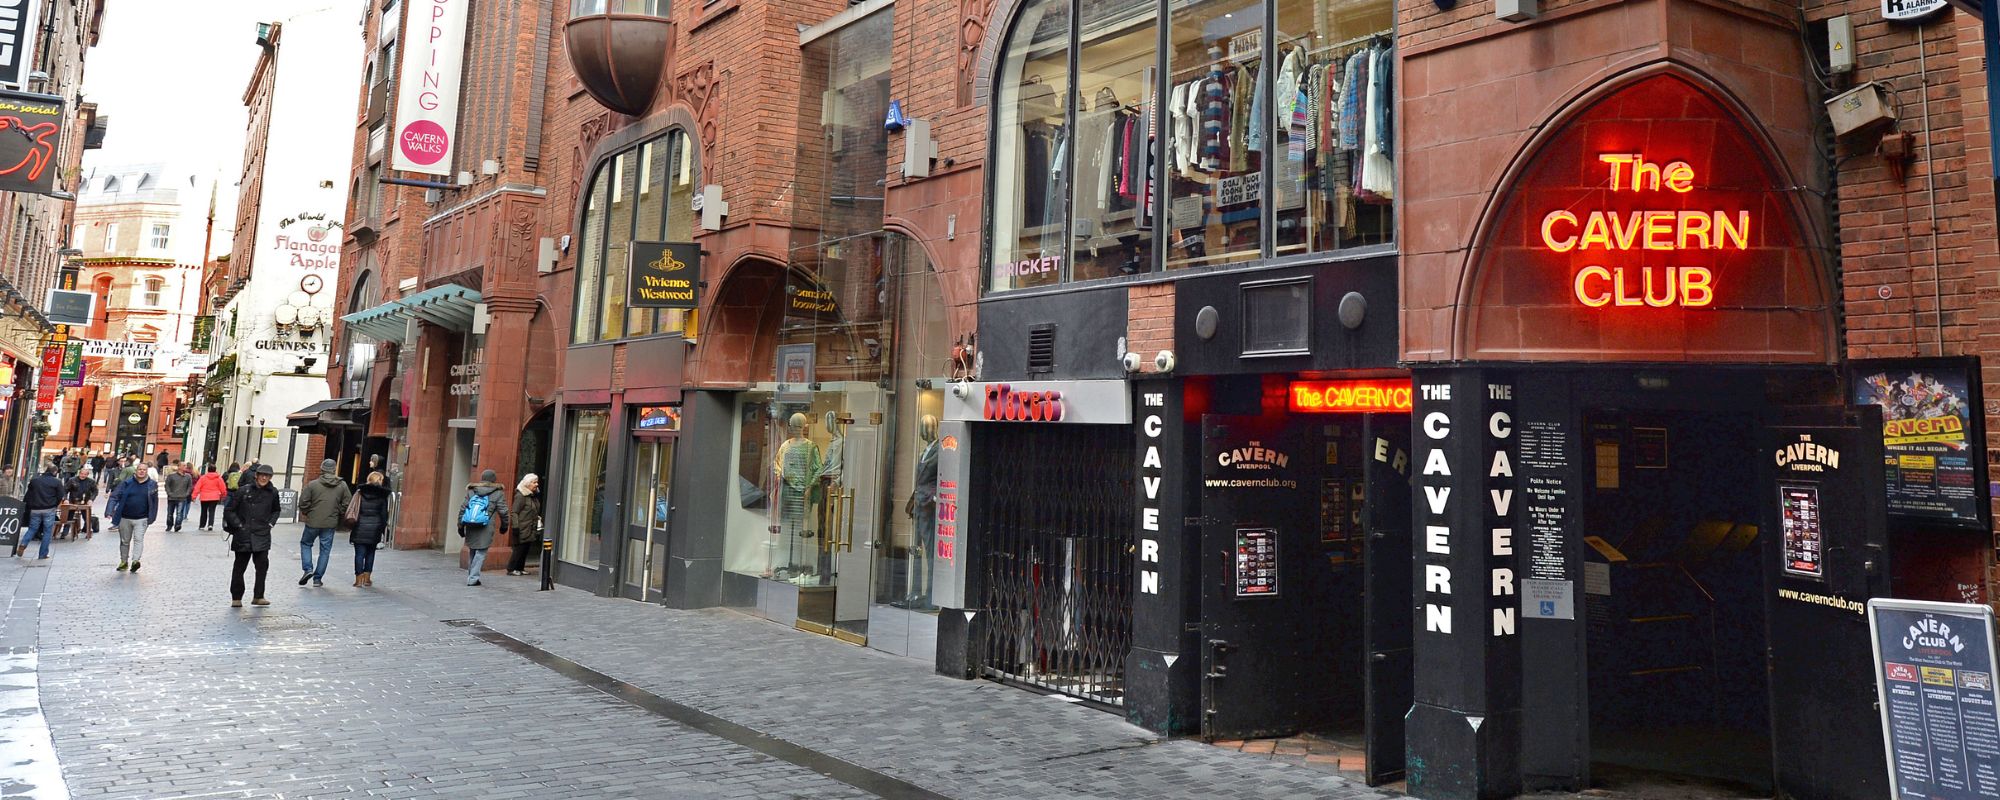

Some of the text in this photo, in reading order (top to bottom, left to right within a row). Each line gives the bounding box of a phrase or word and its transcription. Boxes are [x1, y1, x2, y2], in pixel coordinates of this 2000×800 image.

[419, 0, 448, 110] PPING
[20, 105, 59, 115] social
[403, 131, 445, 145] CAVERN
[407, 141, 442, 154] WALKS
[1599, 154, 1694, 192] The
[298, 211, 326, 221] World
[1541, 209, 1750, 252] CAVERN
[290, 253, 337, 270] Apple
[994, 255, 1061, 279] CRICKET
[642, 275, 691, 288] Vivienne
[1574, 265, 1713, 307] CLUB
[637, 288, 694, 300] Westwood
[256, 340, 316, 351] GUINNESS
[48, 356, 57, 365] 4
[1144, 393, 1163, 406] THE
[1294, 386, 1323, 407] The
[1325, 387, 1393, 407] CAVERN
[1420, 384, 1451, 400] THE
[1488, 384, 1511, 400] THE
[1884, 415, 1962, 436] avern
[1800, 434, 1811, 442] THE
[1218, 447, 1289, 468] CAVERN
[1775, 442, 1840, 470] CAVERN
[1791, 463, 1824, 472] LIVERPOOL
[1205, 478, 1297, 489] www.cavernclub.org
[1141, 414, 1163, 595] CAVERN
[1423, 411, 1451, 634] CAVERN
[1489, 411, 1515, 636] CAVERN
[1778, 588, 1864, 614] www.cavernclub.org
[1903, 618, 1965, 653] CAVERN
[1918, 636, 1946, 648] CLUB
[1890, 666, 1913, 679] CAVERN
